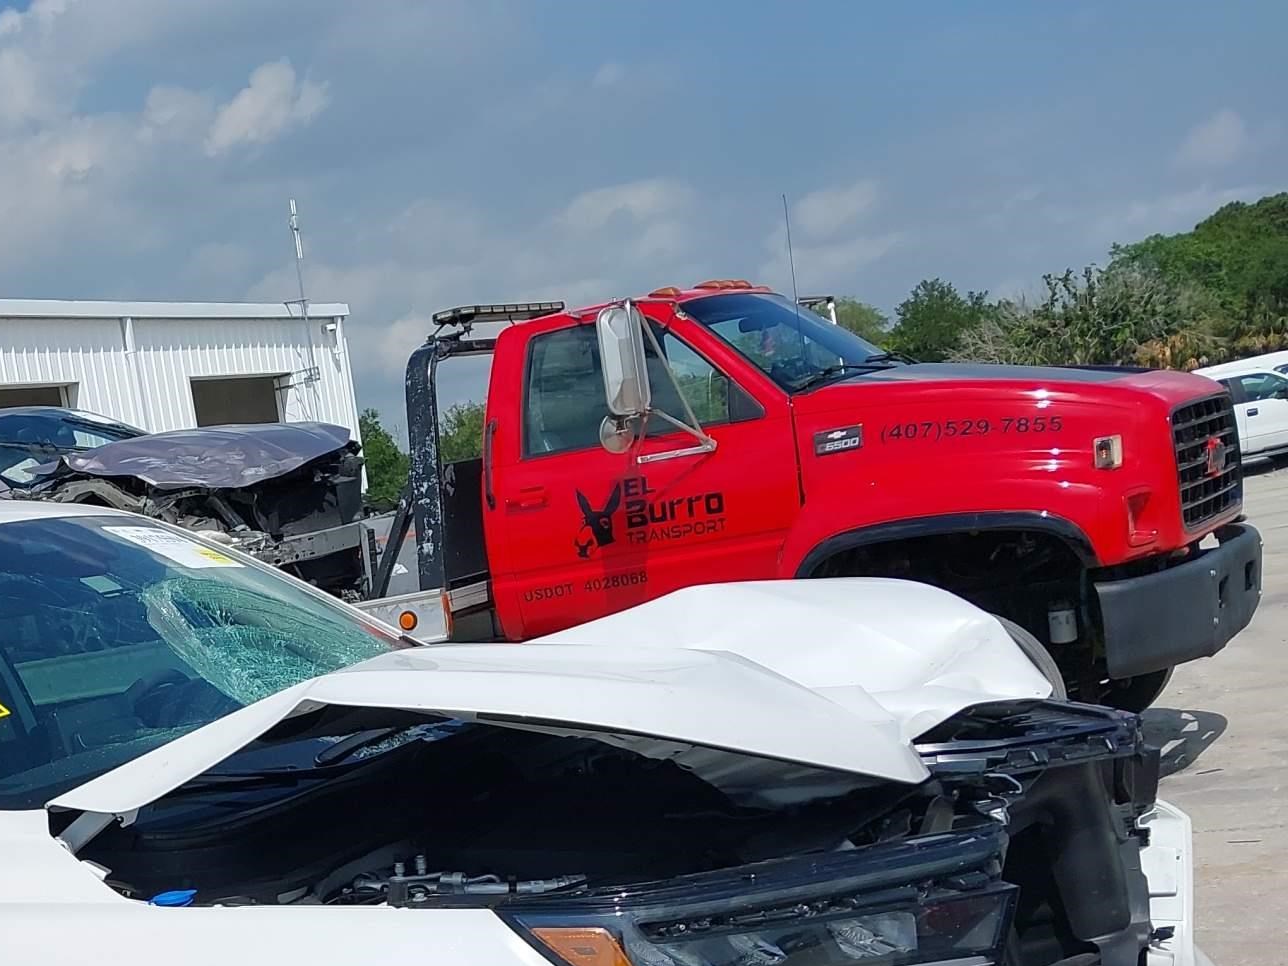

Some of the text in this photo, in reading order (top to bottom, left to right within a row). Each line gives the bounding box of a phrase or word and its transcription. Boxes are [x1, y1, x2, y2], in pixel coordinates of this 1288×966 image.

[880, 415, 1063, 443] (407)529-7855
[623, 476, 656, 497] EL
[626, 517, 728, 545] TRANSPORT
[523, 582, 574, 602] USDOT
